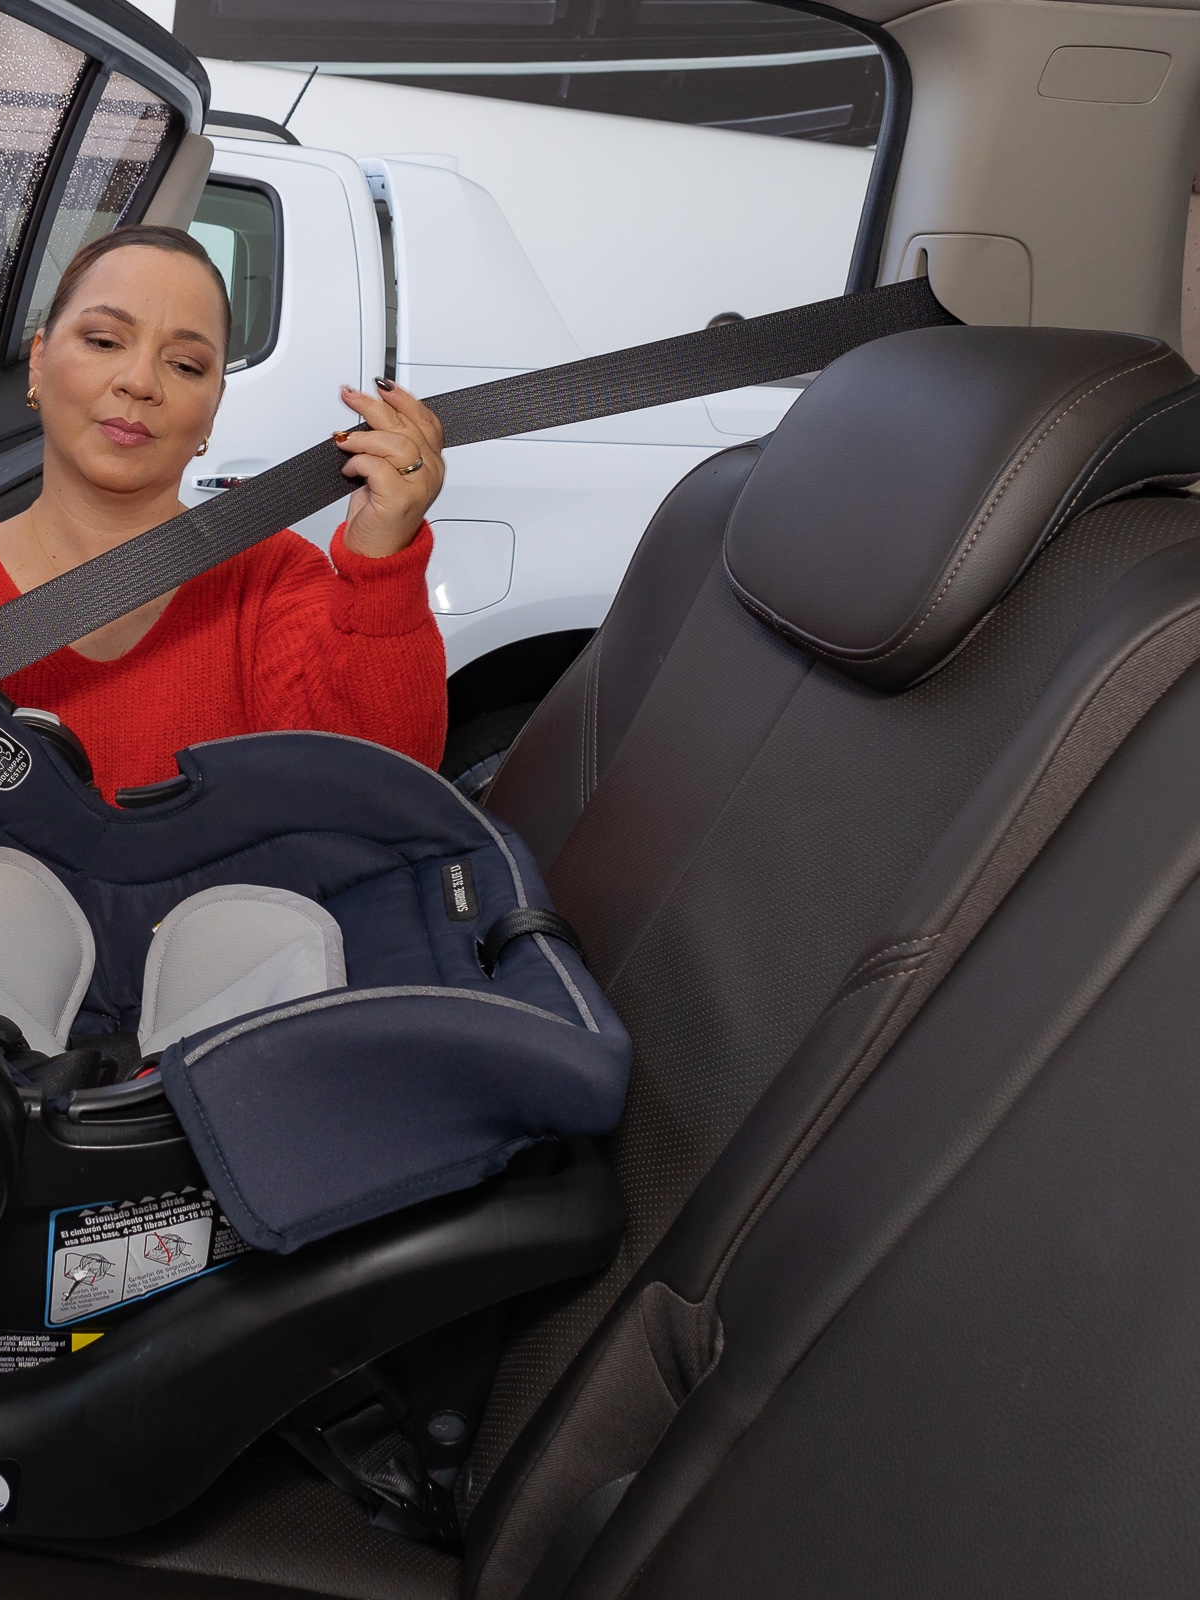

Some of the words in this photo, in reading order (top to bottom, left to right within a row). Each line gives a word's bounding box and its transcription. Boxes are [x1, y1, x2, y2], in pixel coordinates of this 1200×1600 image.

[7, 750, 26, 772] IMPACT
[8, 761, 28, 784] TESTED
[61, 1231, 69, 1239] El
[70, 1224, 101, 1237] cinturón
[102, 1221, 115, 1230] del
[116, 1215, 143, 1227] asiento
[155, 1208, 172, 1219] aquí
[172, 1202, 200, 1214] cuando
[85, 1209, 130, 1226] Orientado
[132, 1202, 158, 1215] hacia
[160, 1196, 185, 1208] atrás
[65, 1239, 79, 1247] usa
[80, 1235, 92, 1243] sin
[93, 1233, 101, 1241] la
[123, 1224, 142, 1234] 4-35
[144, 1219, 167, 1230] libras
[169, 1212, 199, 1225] (1.8-16
[200, 1209, 214, 1219] kg)
